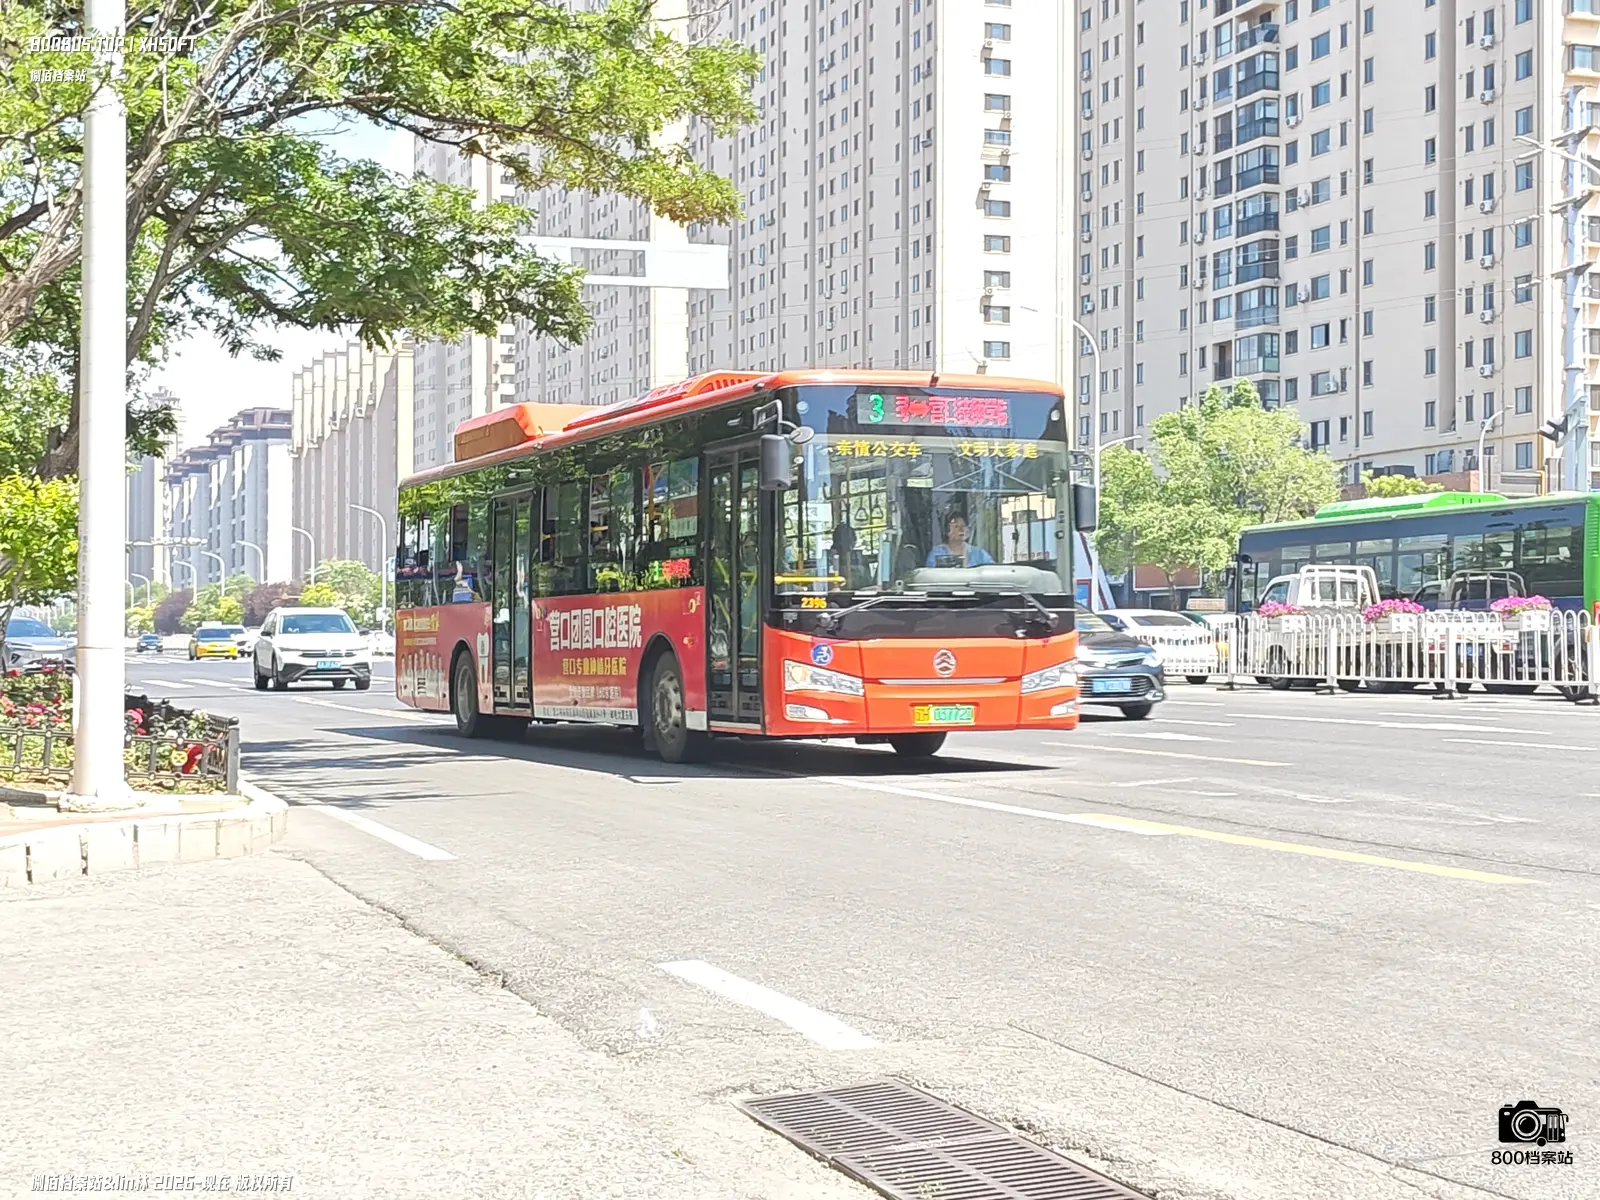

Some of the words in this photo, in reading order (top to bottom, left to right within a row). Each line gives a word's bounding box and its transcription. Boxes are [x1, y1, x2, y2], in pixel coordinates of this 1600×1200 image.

[868, 394, 884, 423] 3
[957, 441, 1040, 459] 文明大家庭
[549, 604, 642, 651] 营口团圆口腔医院
[562, 656, 627, 676] 营口专业种植牙医院
